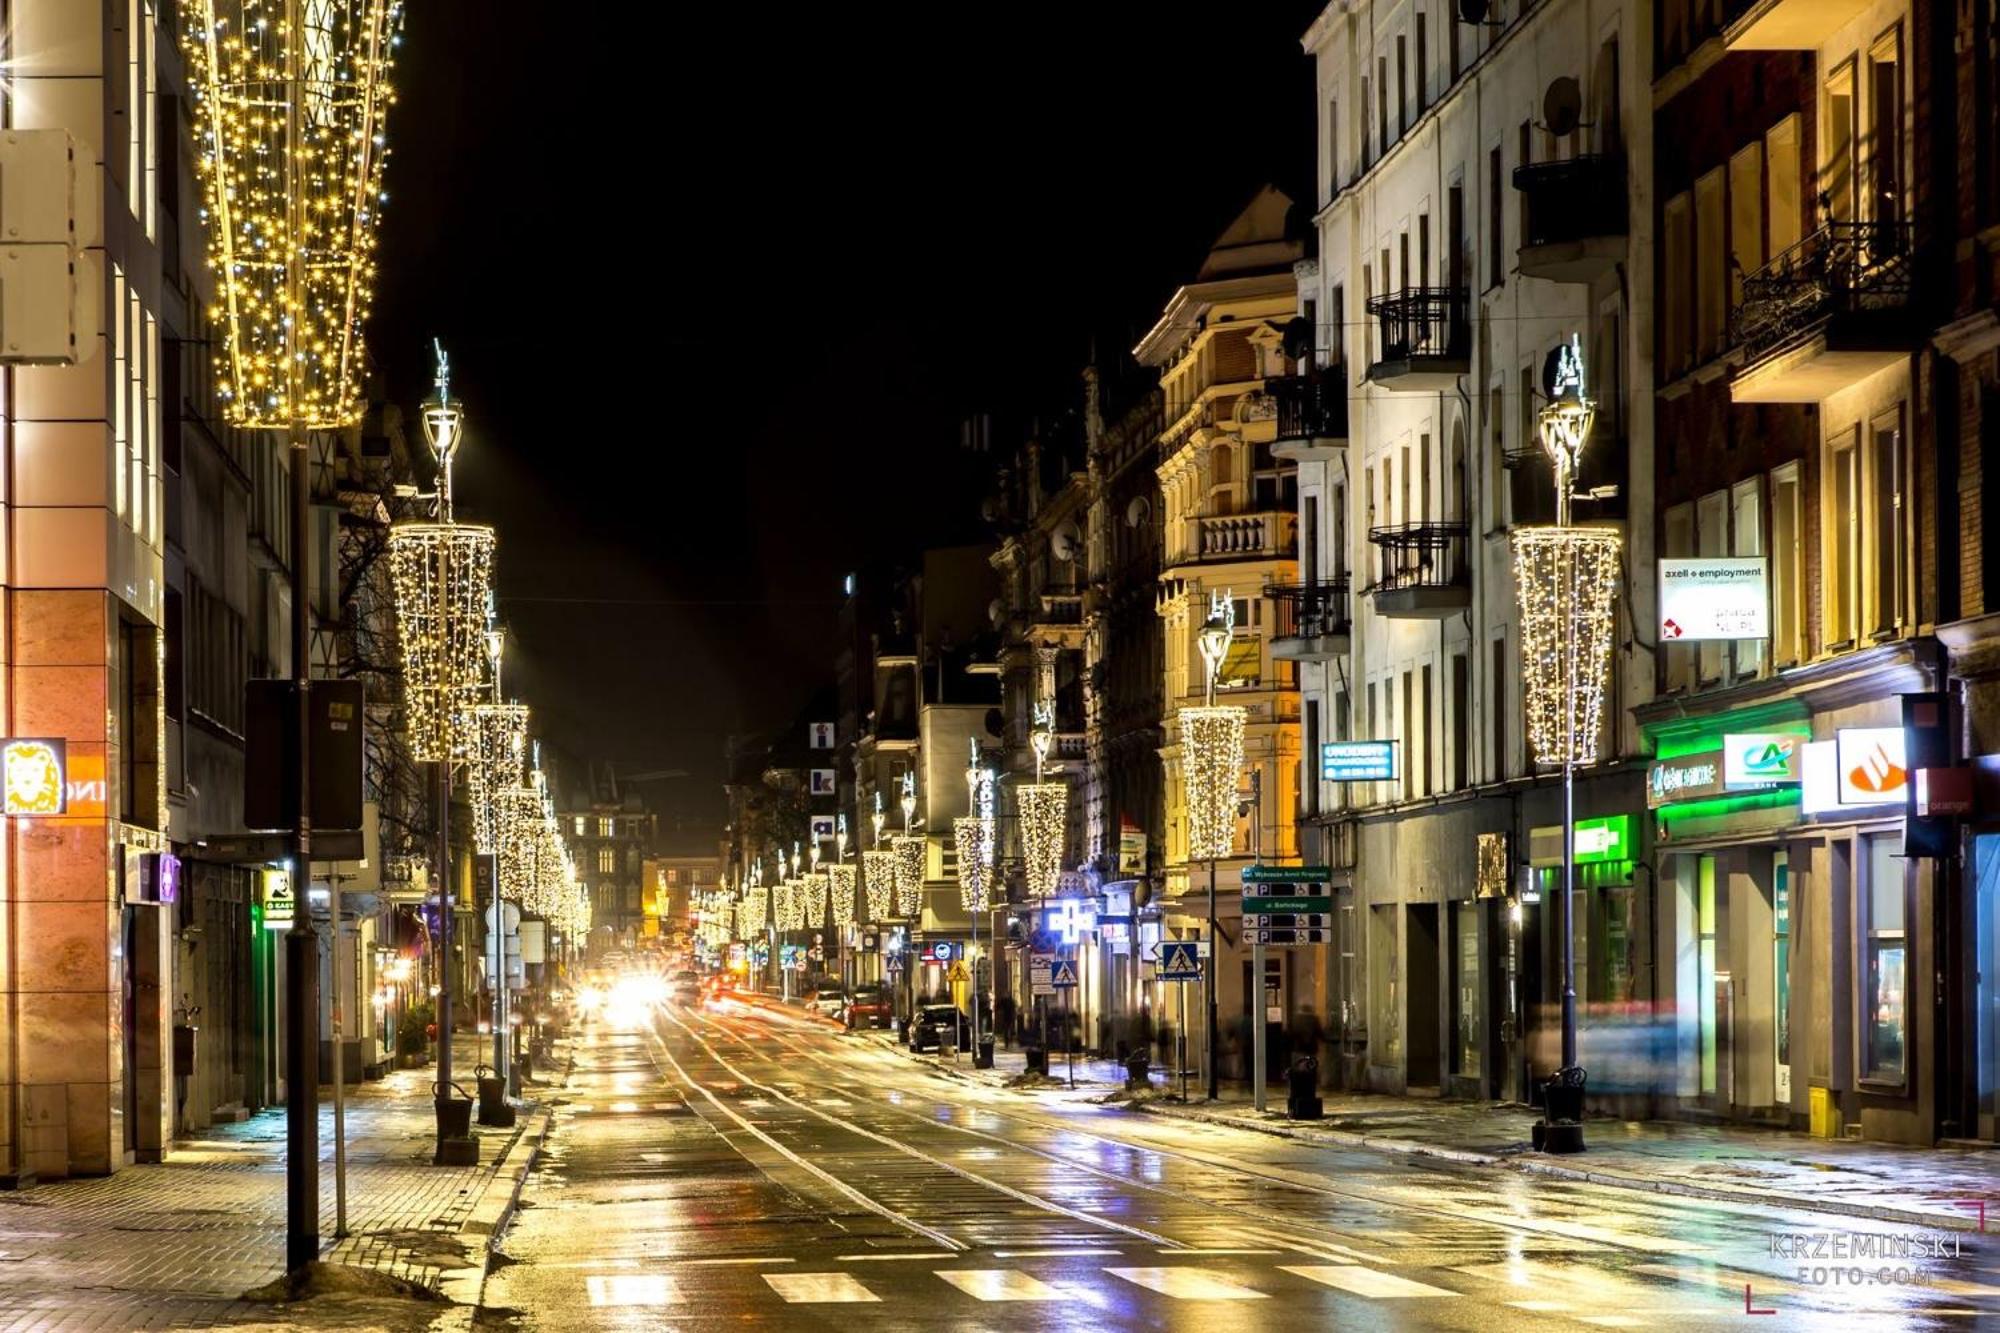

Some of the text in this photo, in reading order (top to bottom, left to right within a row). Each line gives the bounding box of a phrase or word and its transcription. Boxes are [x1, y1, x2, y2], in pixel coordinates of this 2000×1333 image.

[1665, 567, 1761, 578] axell employment
[1260, 884, 1268, 896] P
[1260, 916, 1268, 927] P
[1260, 931, 1268, 942] P
